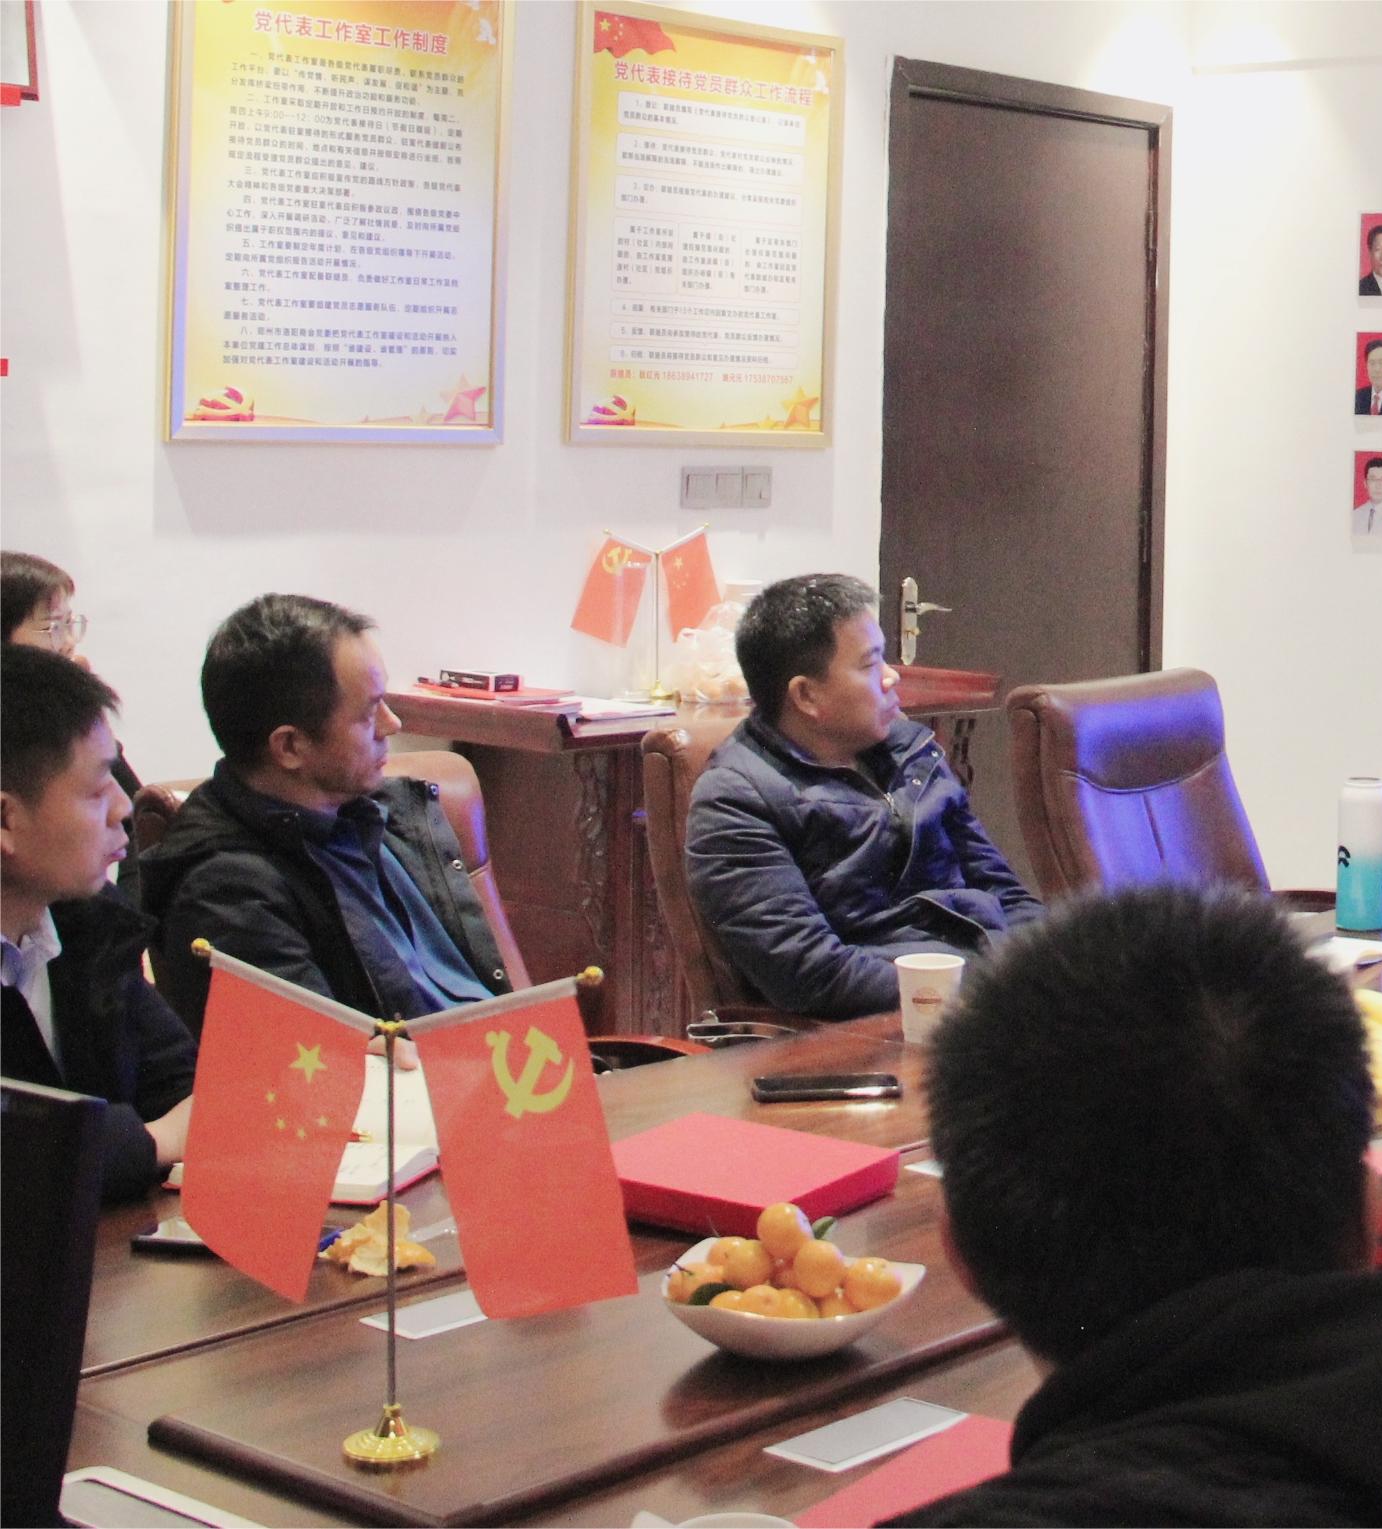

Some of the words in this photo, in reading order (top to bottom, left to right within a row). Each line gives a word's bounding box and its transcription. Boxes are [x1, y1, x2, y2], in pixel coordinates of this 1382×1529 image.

[254, 11, 449, 54] 党代表工作室工作制度
[614, 61, 815, 106] 党代表接待党员群众工作流程
